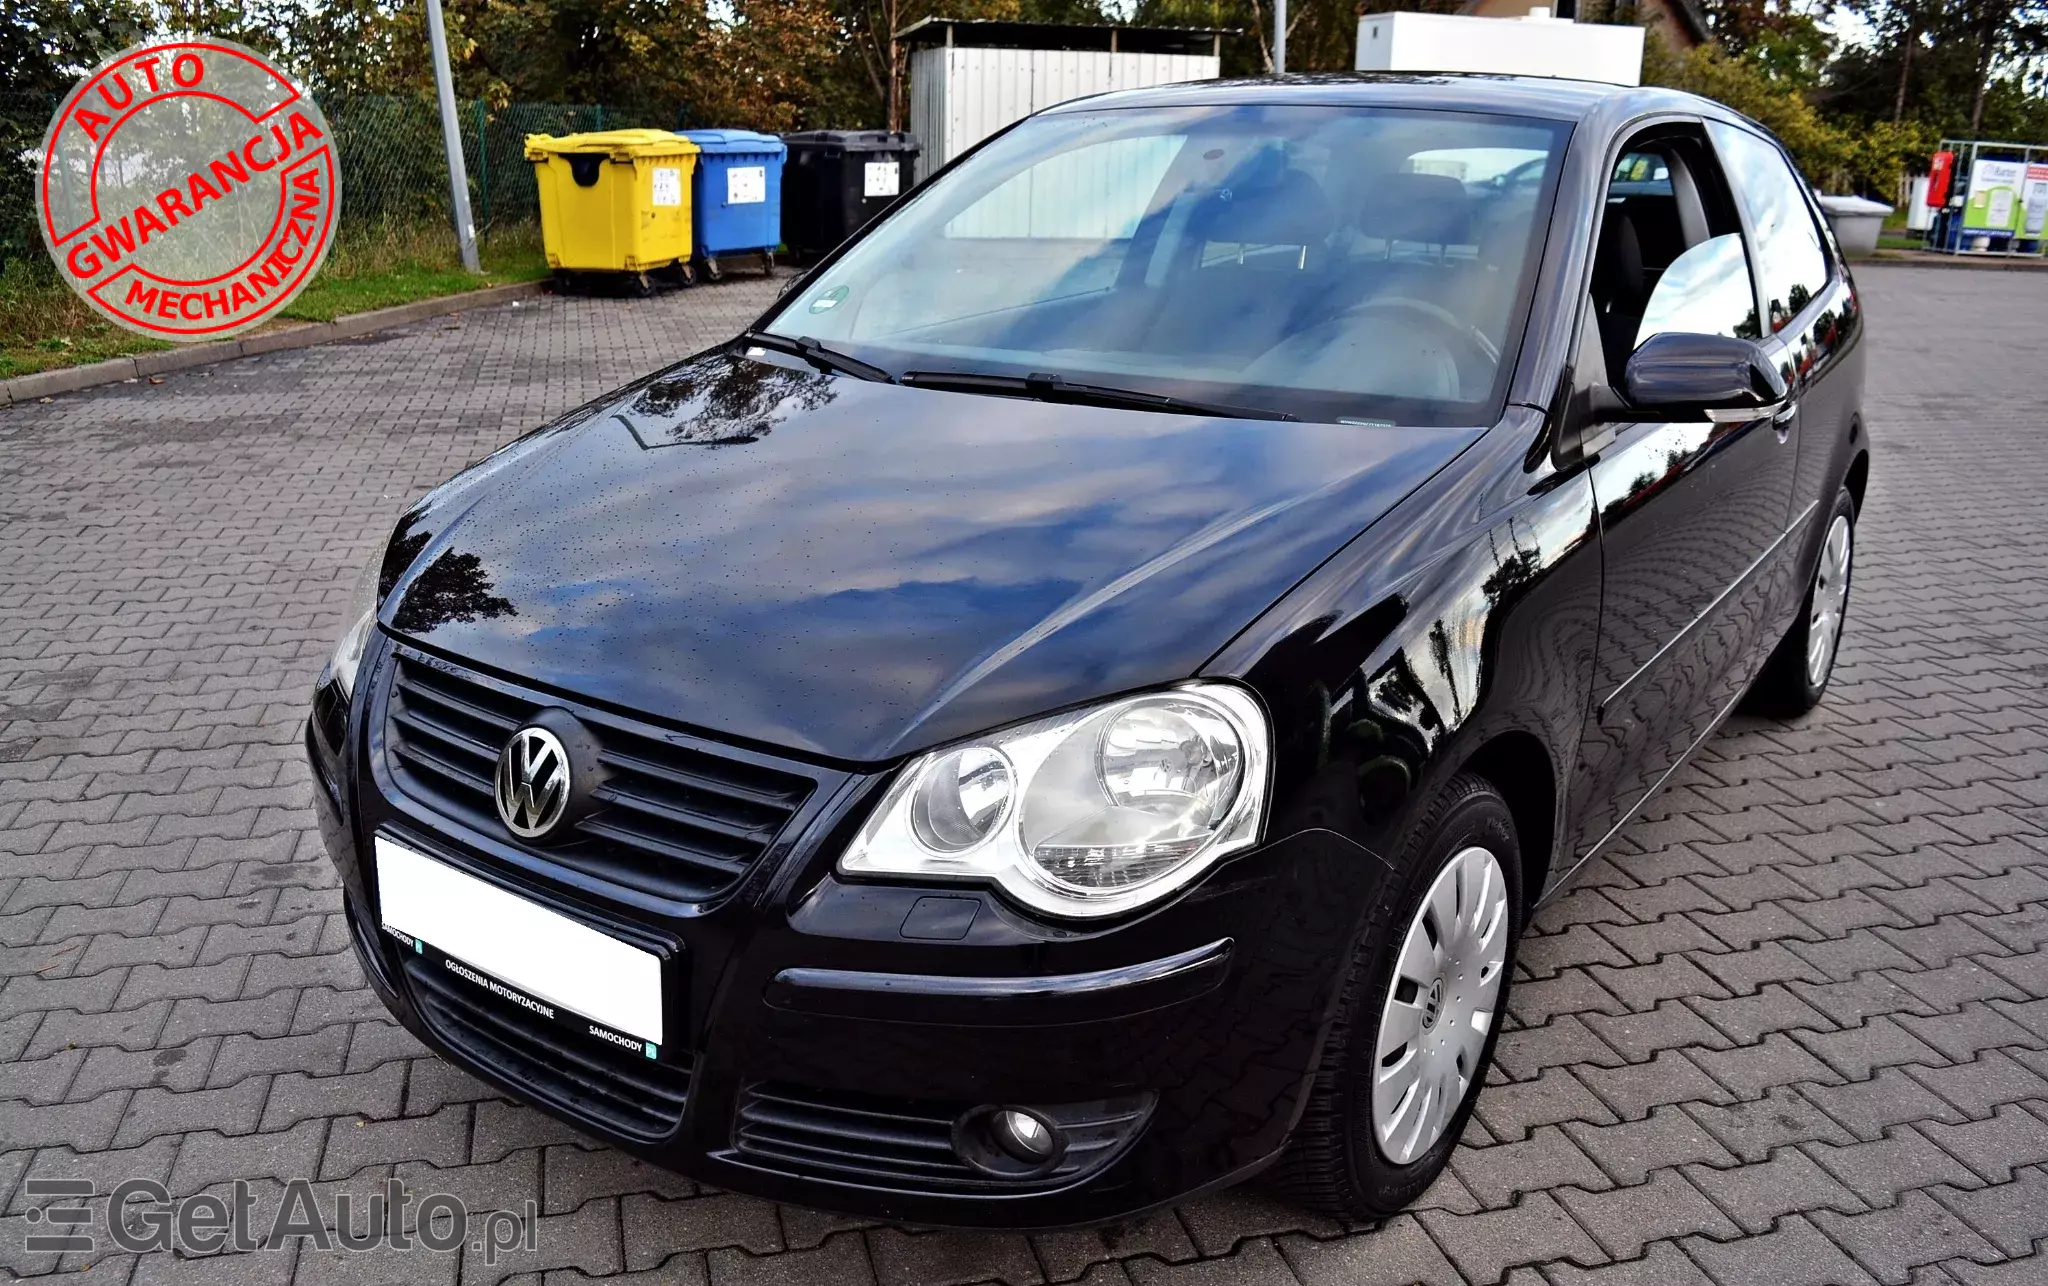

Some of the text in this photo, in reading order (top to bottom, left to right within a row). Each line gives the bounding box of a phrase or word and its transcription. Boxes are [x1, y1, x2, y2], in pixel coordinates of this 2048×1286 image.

[445, 959, 555, 1019] OGŁOSZENIA MOTORYZACYJNE
[589, 1025, 643, 1052] SAMOCHODY
